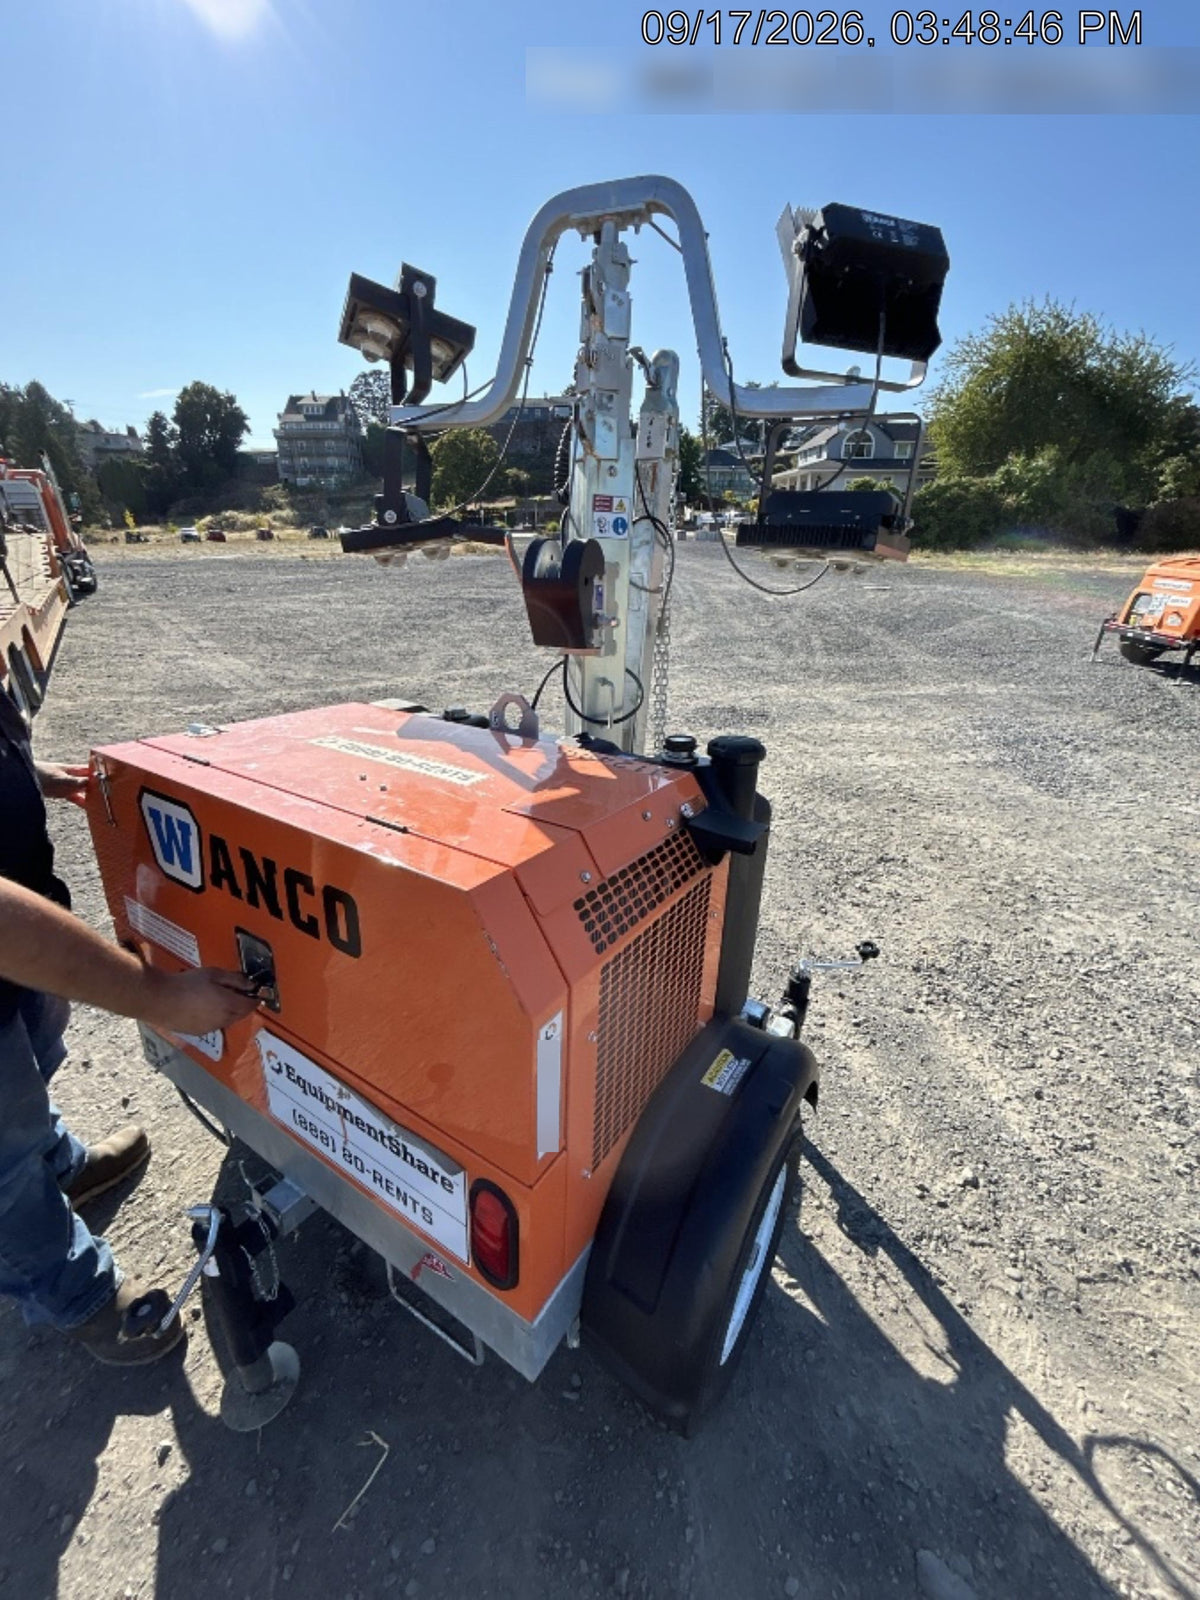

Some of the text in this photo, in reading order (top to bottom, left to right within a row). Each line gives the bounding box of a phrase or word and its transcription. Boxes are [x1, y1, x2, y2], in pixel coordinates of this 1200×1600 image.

[147, 806, 362, 959] WANCO
[284, 1061, 455, 1194] EquipmentShare
[291, 1107, 434, 1226] (888) 80-RENTS
